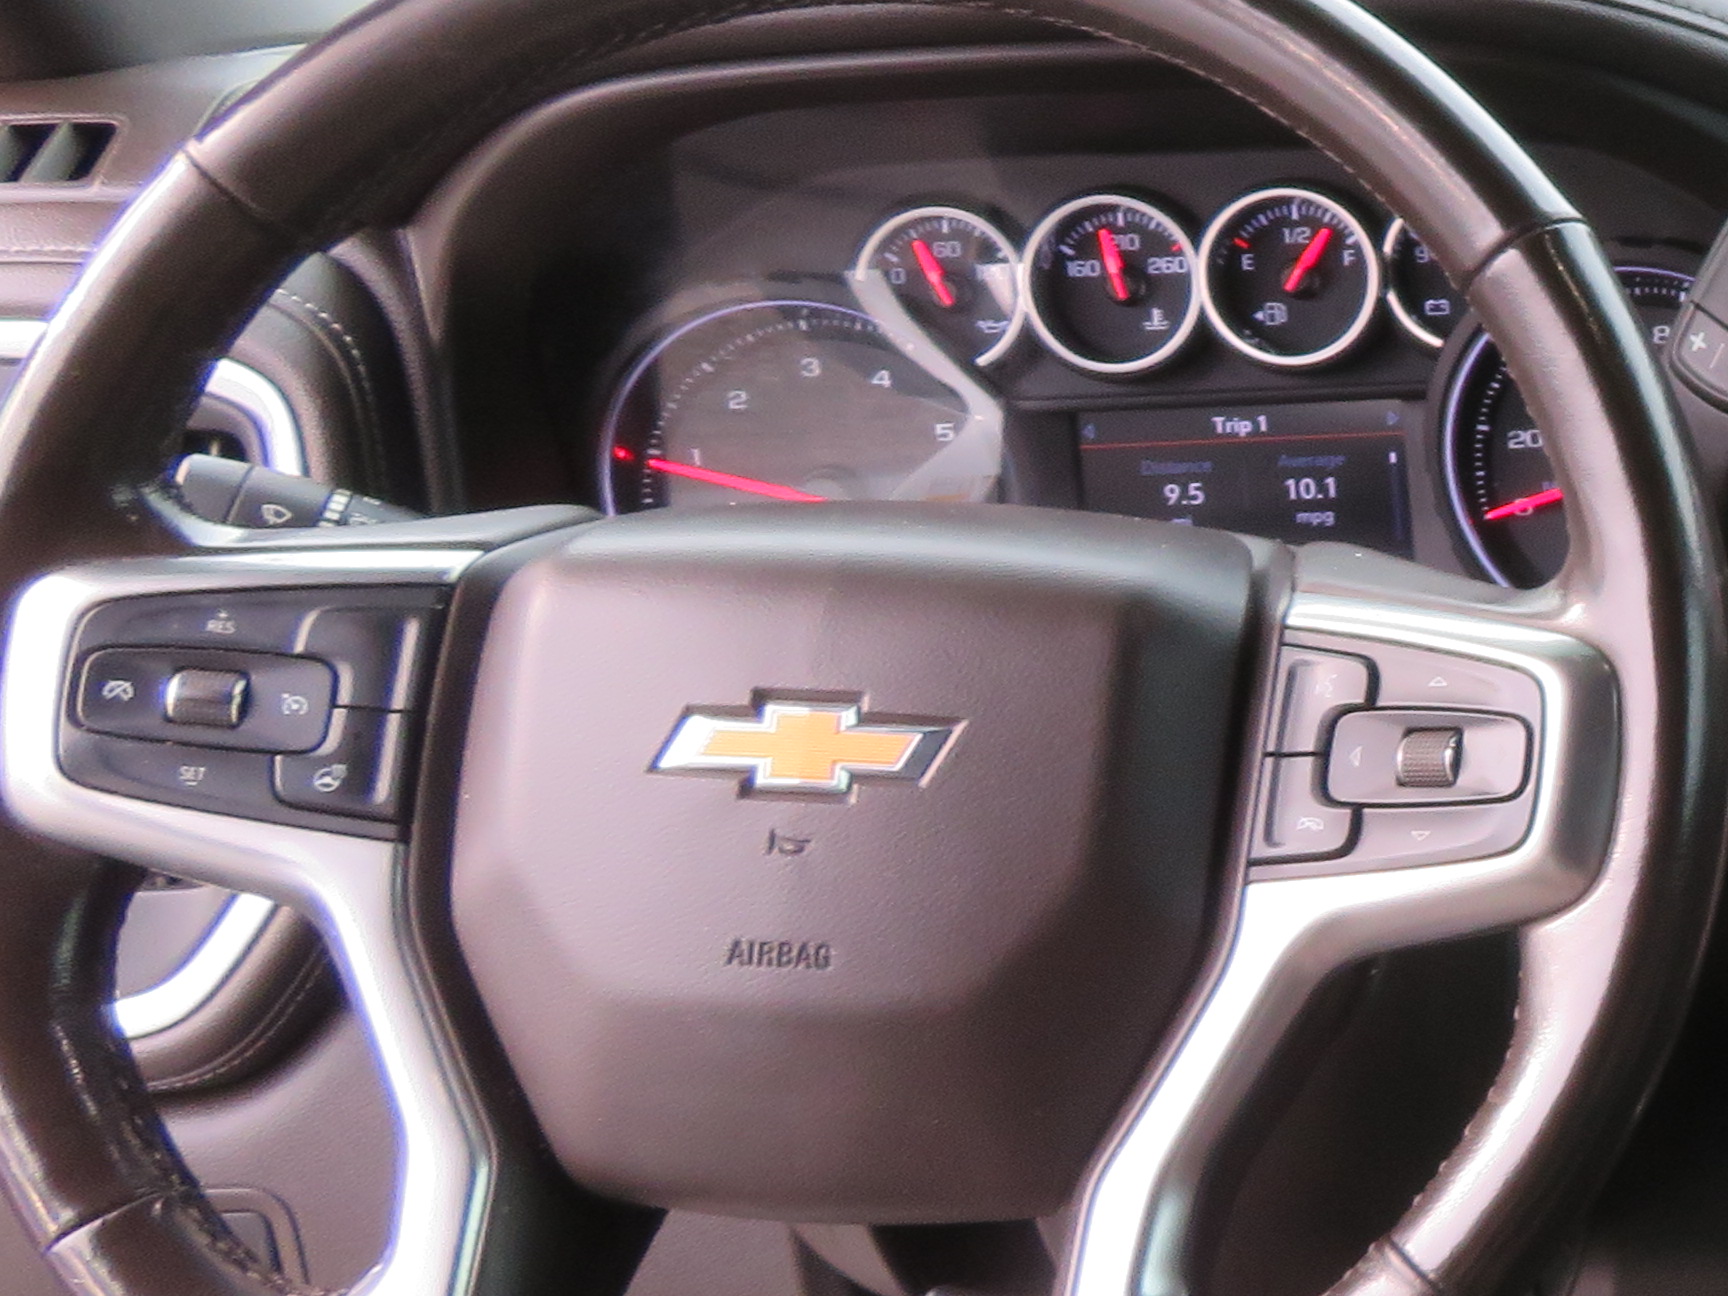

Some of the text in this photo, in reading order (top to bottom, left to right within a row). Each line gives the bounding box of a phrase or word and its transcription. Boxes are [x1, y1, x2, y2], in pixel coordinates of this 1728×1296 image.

[1282, 226, 1312, 244] 1/2
[932, 241, 961, 256] 60
[1342, 249, 1357, 266] F
[1066, 260, 1099, 277] 160
[1148, 256, 1187, 274] 260
[1241, 254, 1255, 271] E
[889, 267, 906, 284] 0
[801, 357, 822, 377] 3
[870, 369, 892, 388] 4
[726, 390, 749, 410] 2
[934, 423, 955, 442] 5
[1211, 415, 1268, 438] Trip 1
[1506, 429, 1543, 450] 20
[690, 448, 702, 466] 1
[1163, 476, 1337, 505] 9.5 10.1
[1294, 510, 1336, 527] mpg
[206, 619, 237, 634] RES
[179, 765, 206, 781] SET
[725, 938, 833, 970] AIRBAG
